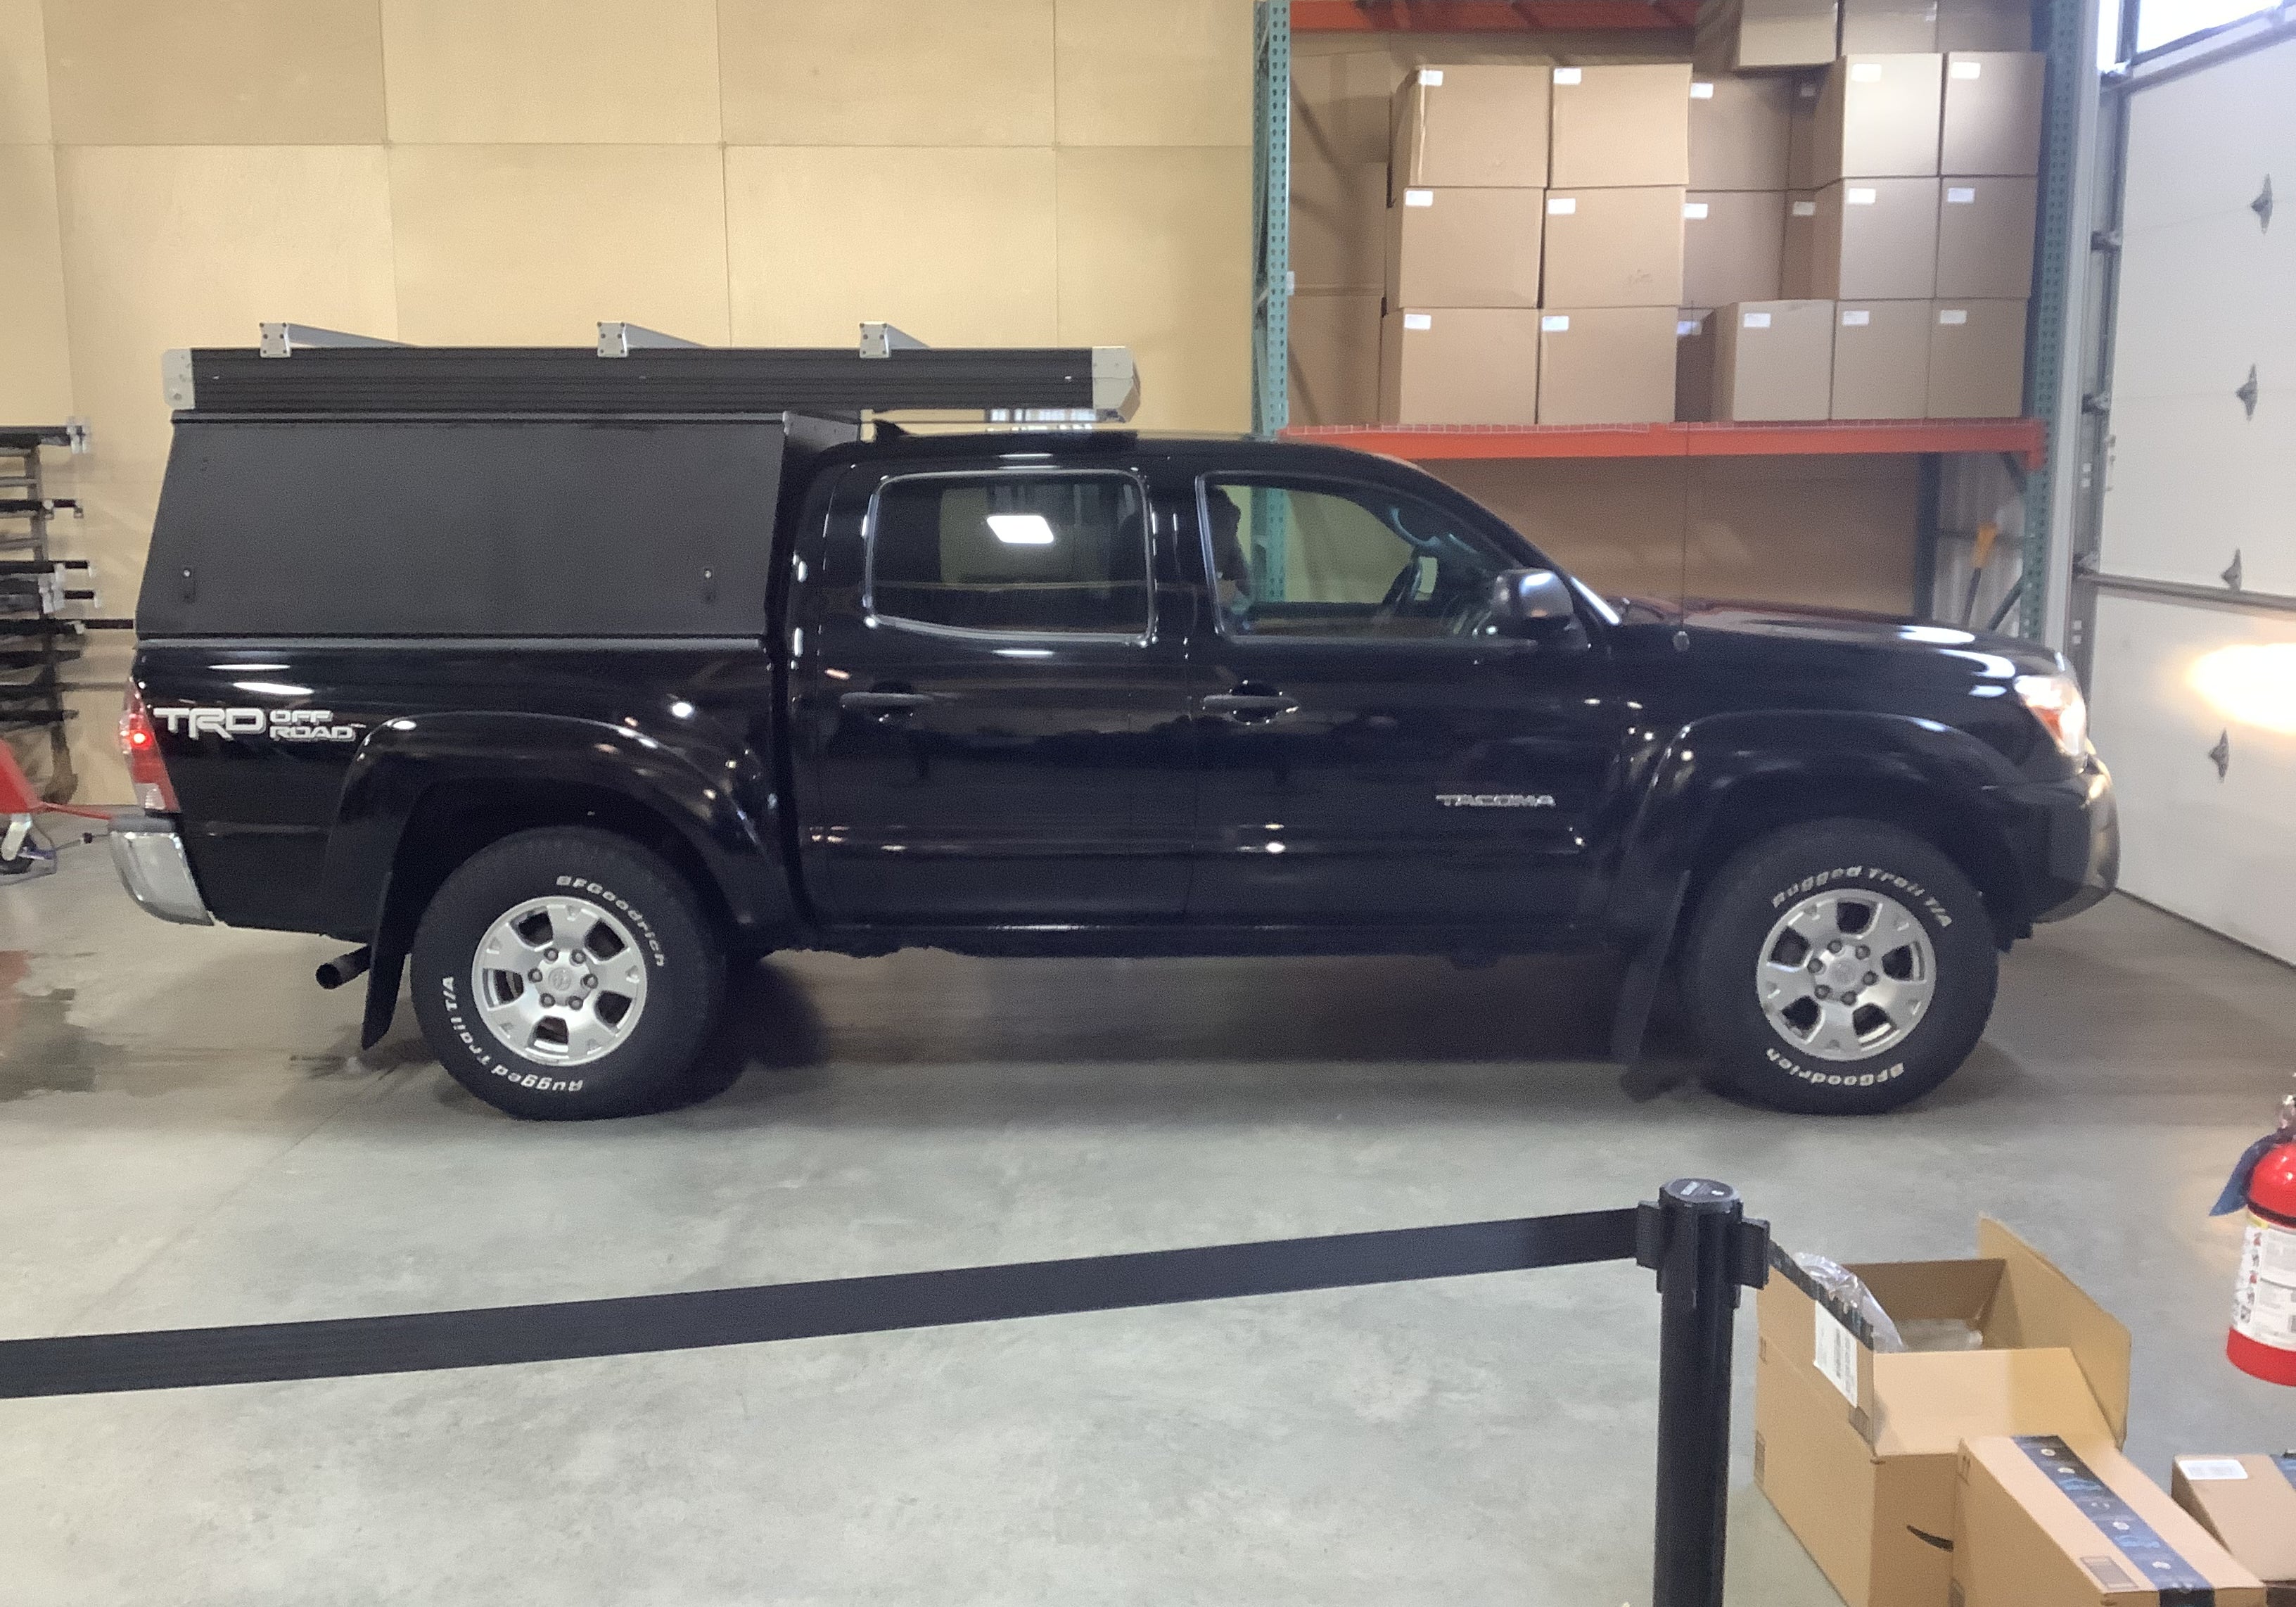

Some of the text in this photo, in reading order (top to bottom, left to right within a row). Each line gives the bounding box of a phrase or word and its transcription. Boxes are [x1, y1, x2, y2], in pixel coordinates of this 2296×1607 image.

[153, 707, 266, 741] TRD
[269, 709, 333, 725] OFF
[269, 725, 355, 742] ROAD
[1436, 794, 1556, 807] TACOMA
[1772, 866, 1863, 908] Rugged
[1868, 867, 1925, 896] Trail
[442, 976, 583, 1092] Rugged Trail T/A
